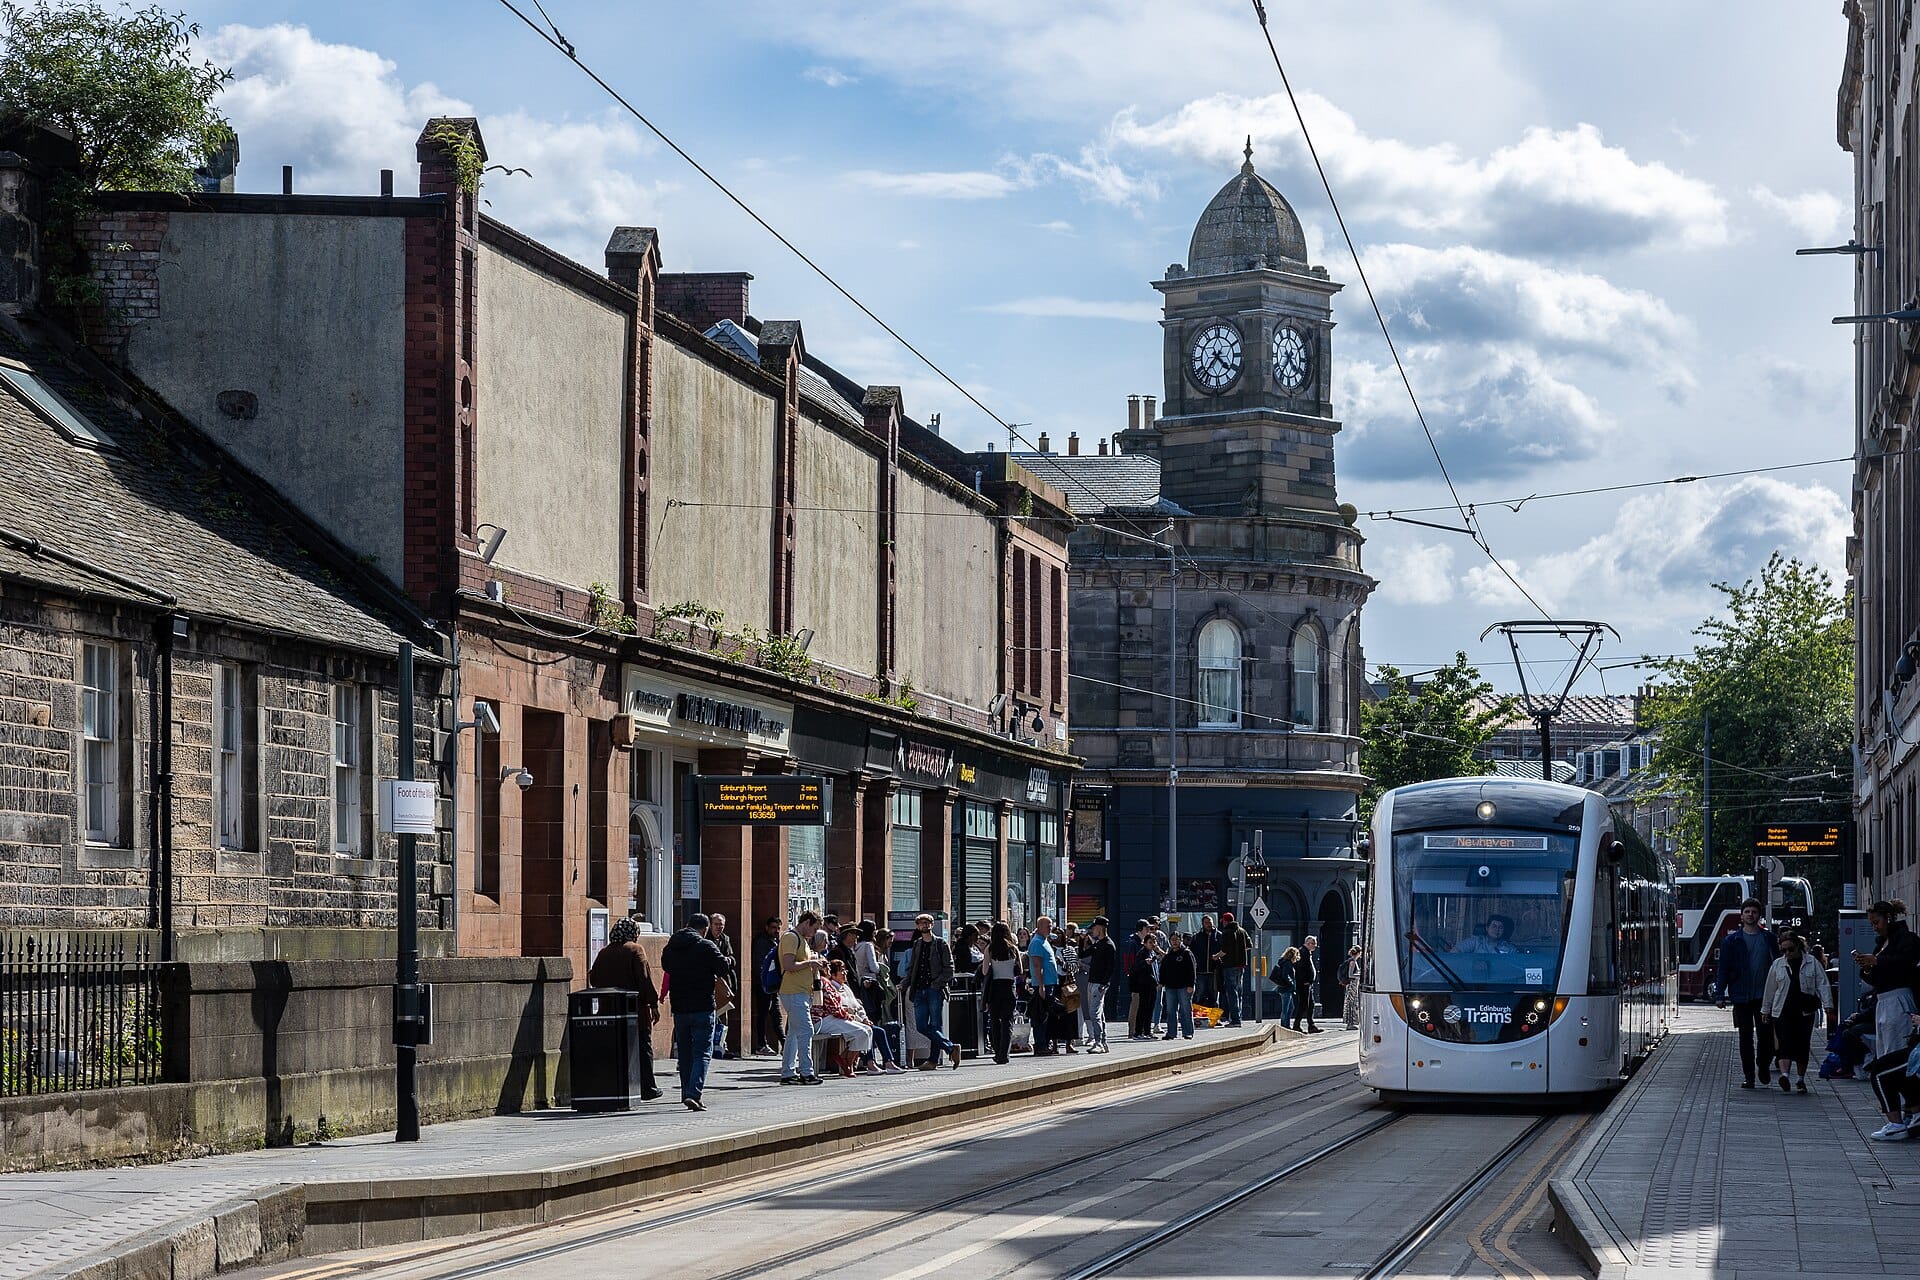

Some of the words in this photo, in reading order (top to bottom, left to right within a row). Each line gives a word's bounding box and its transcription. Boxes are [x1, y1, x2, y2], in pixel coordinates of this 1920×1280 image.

[397, 787, 412, 798] Foot
[720, 784, 746, 793] Edinburgh
[747, 784, 767, 792] Airport
[720, 793, 746, 802] Edinburgh
[747, 793, 767, 801] Airport
[774, 803, 793, 811] Tripper
[1457, 836, 1515, 847] Newhaven
[1254, 908, 1265, 917] 15
[1791, 917, 1801, 927] 16
[1526, 973, 1542, 981] 966
[1479, 1004, 1512, 1014] Edinburgh
[1464, 1007, 1512, 1024] Trams
